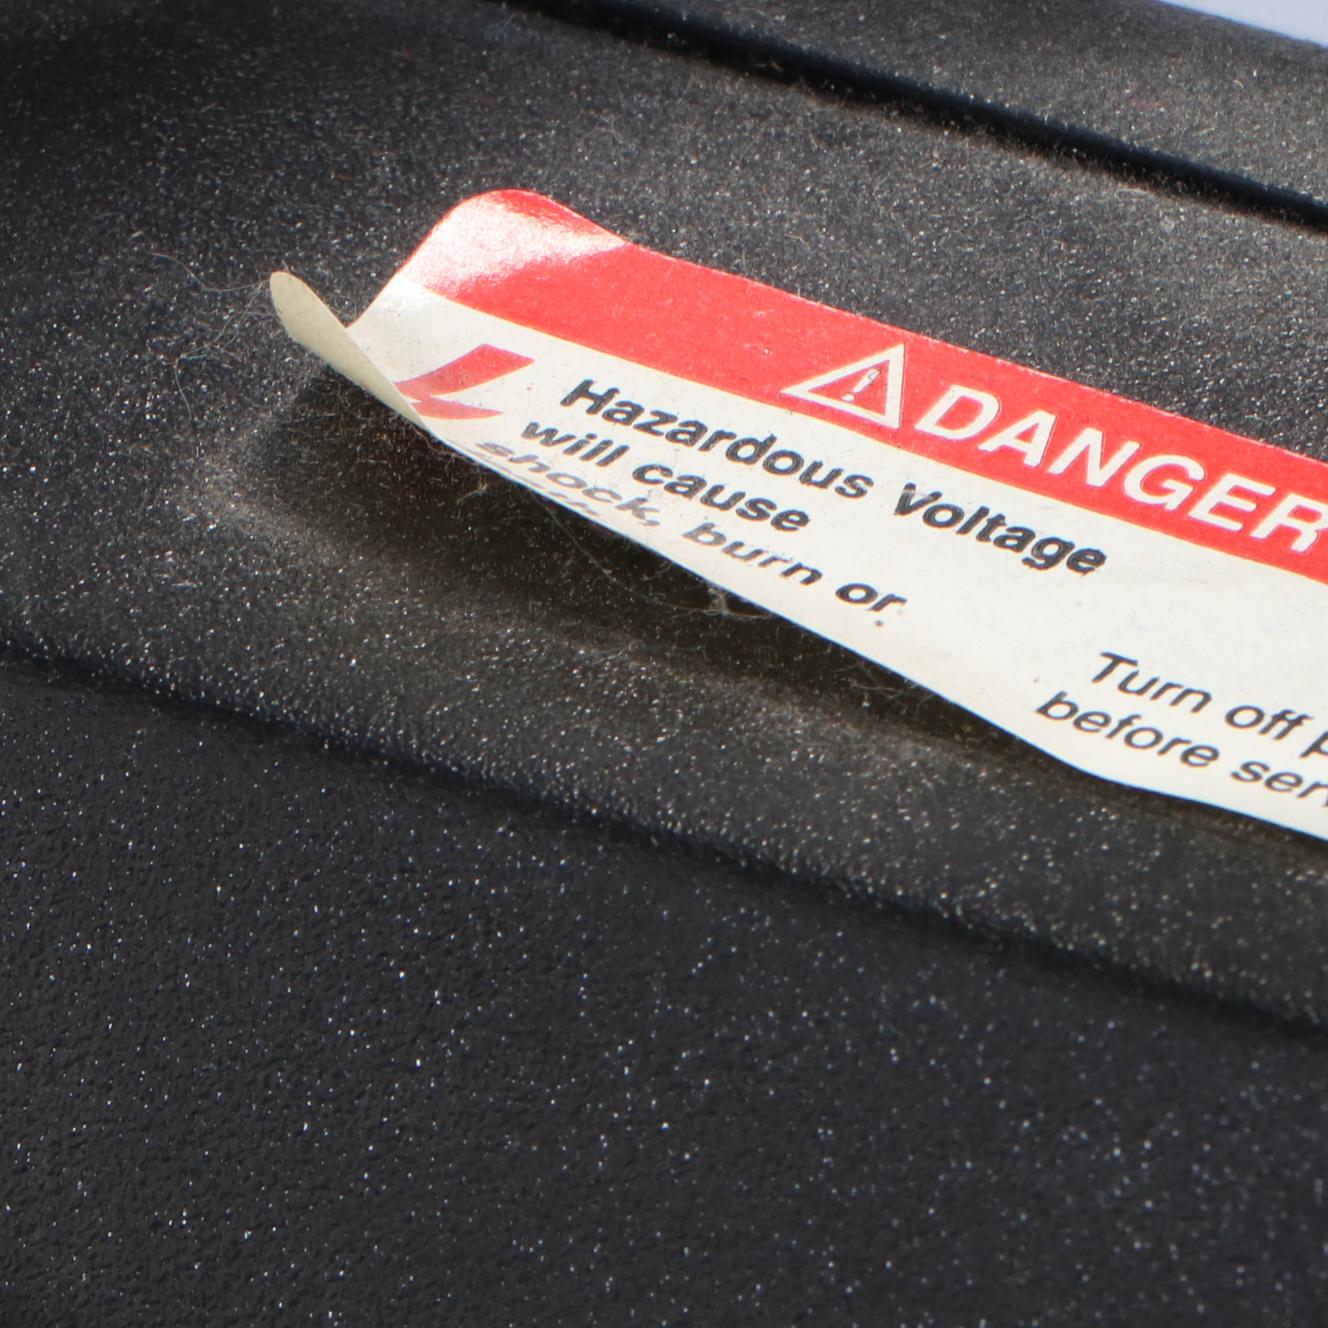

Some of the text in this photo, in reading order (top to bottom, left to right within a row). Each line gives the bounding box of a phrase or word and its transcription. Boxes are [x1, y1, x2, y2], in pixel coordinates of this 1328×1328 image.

[521, 421, 630, 468] will
[631, 460, 811, 533] cause
[561, 378, 876, 502] Hazardous
[893, 482, 1107, 581] Voltage
[682, 521, 823, 586] burn
[1035, 690, 1220, 769] before
[1089, 650, 1213, 713] Turn
[1222, 700, 1315, 741] off
